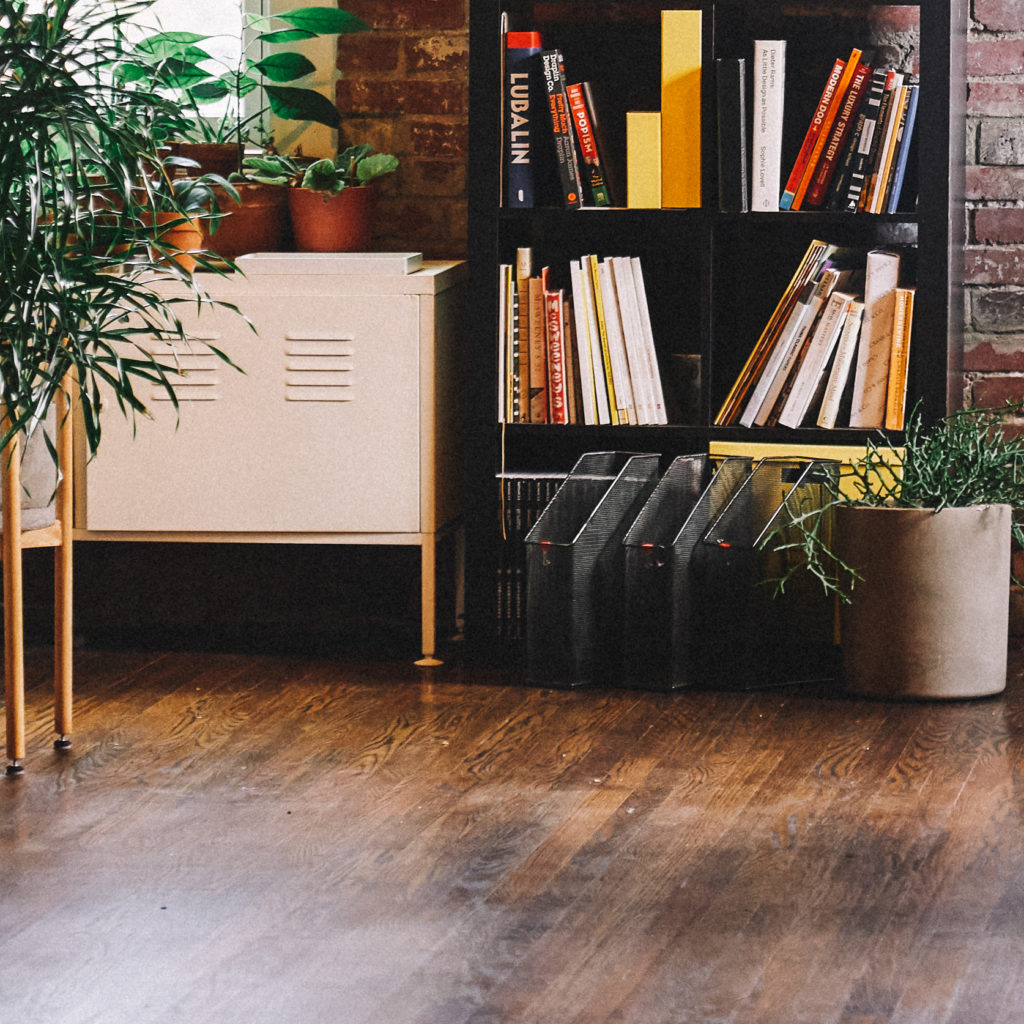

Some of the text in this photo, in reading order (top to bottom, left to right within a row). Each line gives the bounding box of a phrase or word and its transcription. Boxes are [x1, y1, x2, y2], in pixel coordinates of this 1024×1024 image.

[549, 54, 560, 81] Draplin
[762, 49, 768, 57] As
[542, 55, 555, 92] Design Co.
[822, 64, 844, 105] MODERN
[852, 74, 864, 90] THE
[510, 73, 531, 164] LUBALIN
[548, 94, 560, 133] Everything
[814, 104, 827, 125] DOG
[840, 90, 858, 121] LUXURY
[559, 114, 568, 134] Much
[577, 111, 592, 154] POPISM
[563, 136, 572, 157] Aaron
[825, 121, 846, 161] STRATEGY
